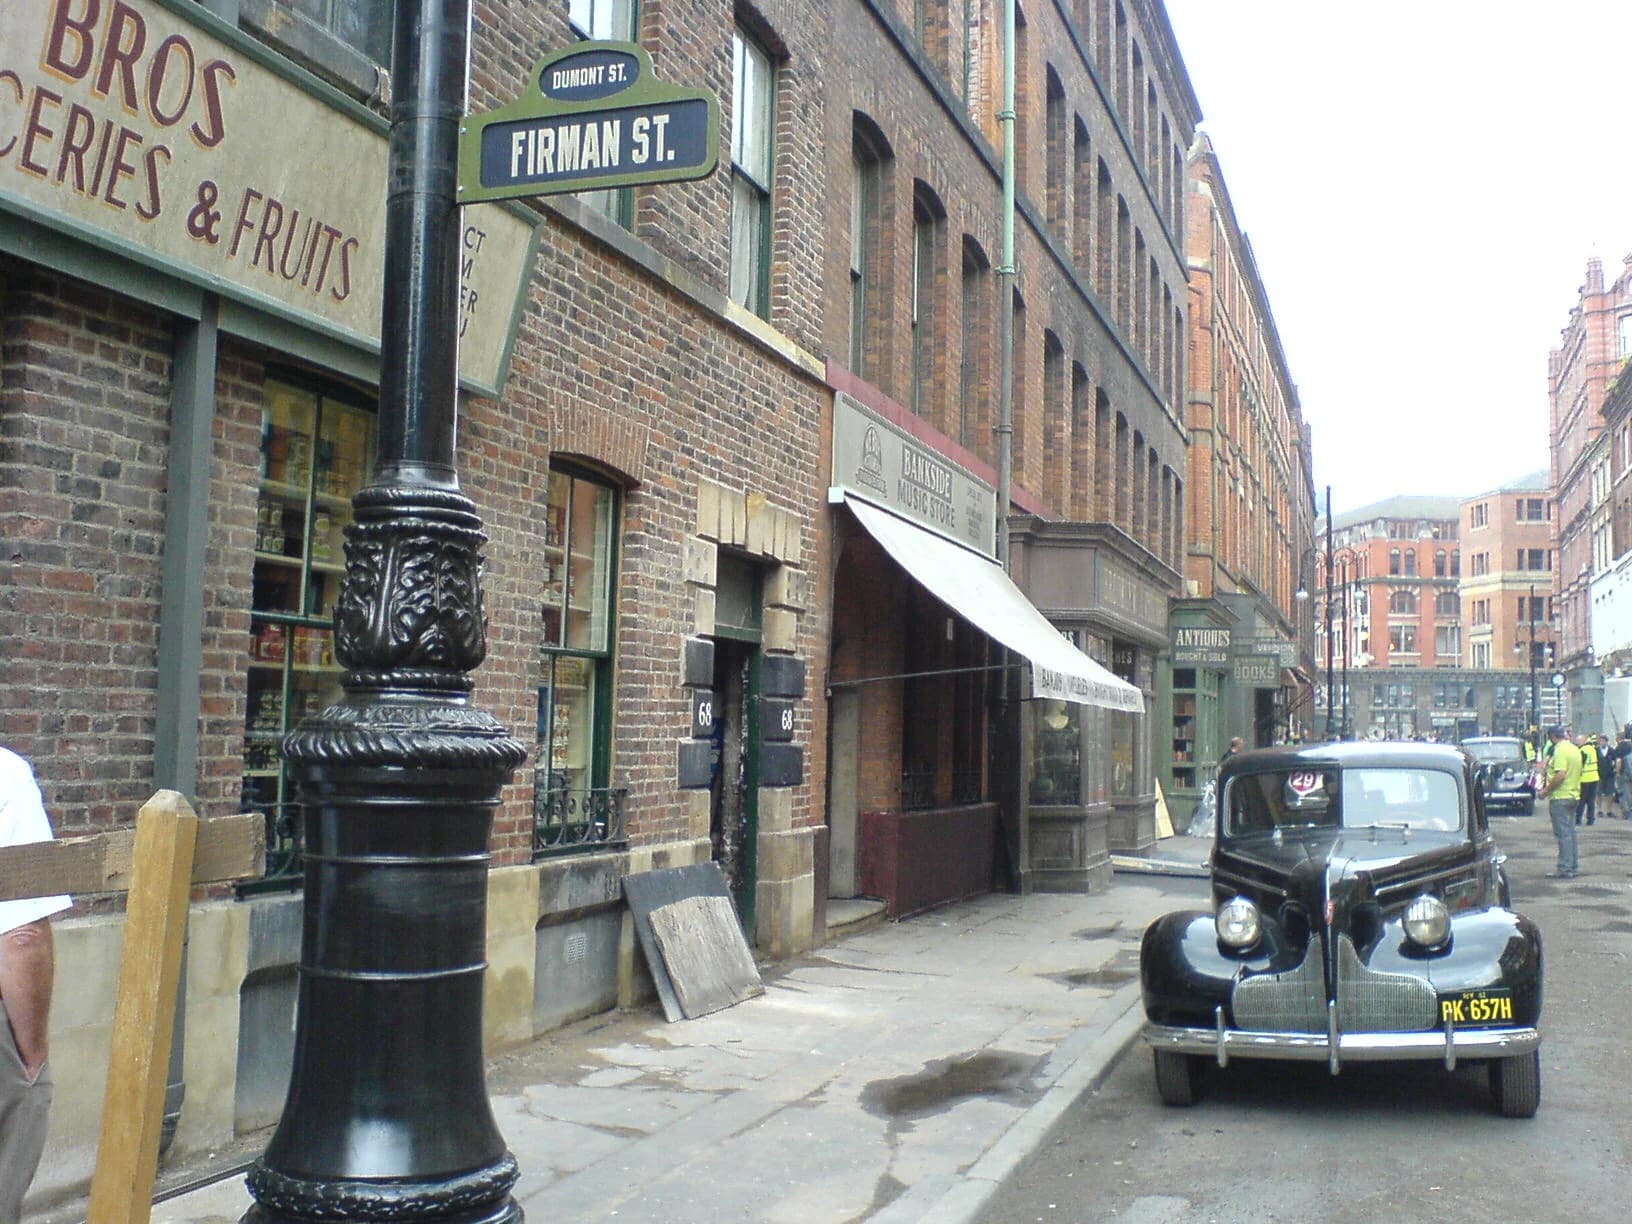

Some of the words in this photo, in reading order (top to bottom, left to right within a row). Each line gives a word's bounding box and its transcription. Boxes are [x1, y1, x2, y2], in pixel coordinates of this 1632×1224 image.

[42, 0, 236, 149] BROS
[553, 66, 604, 90] DUMONT
[608, 63, 627, 83] ST.
[511, 119, 621, 177] FIRMAN
[632, 114, 675, 164] ST.
[187, 180, 222, 245] &
[230, 187, 360, 302] FRUITS
[904, 448, 951, 499] BANKSIDE
[898, 480, 928, 515] MUSIC
[929, 497, 956, 529] STORE
[1176, 629, 1231, 647] ANTIQUES
[1234, 665, 1276, 680] BOOKS
[698, 702, 712, 726] 68
[781, 709, 793, 730] 68
[1292, 772, 1316, 788] 29
[1470, 997, 1512, 1020] 657H
